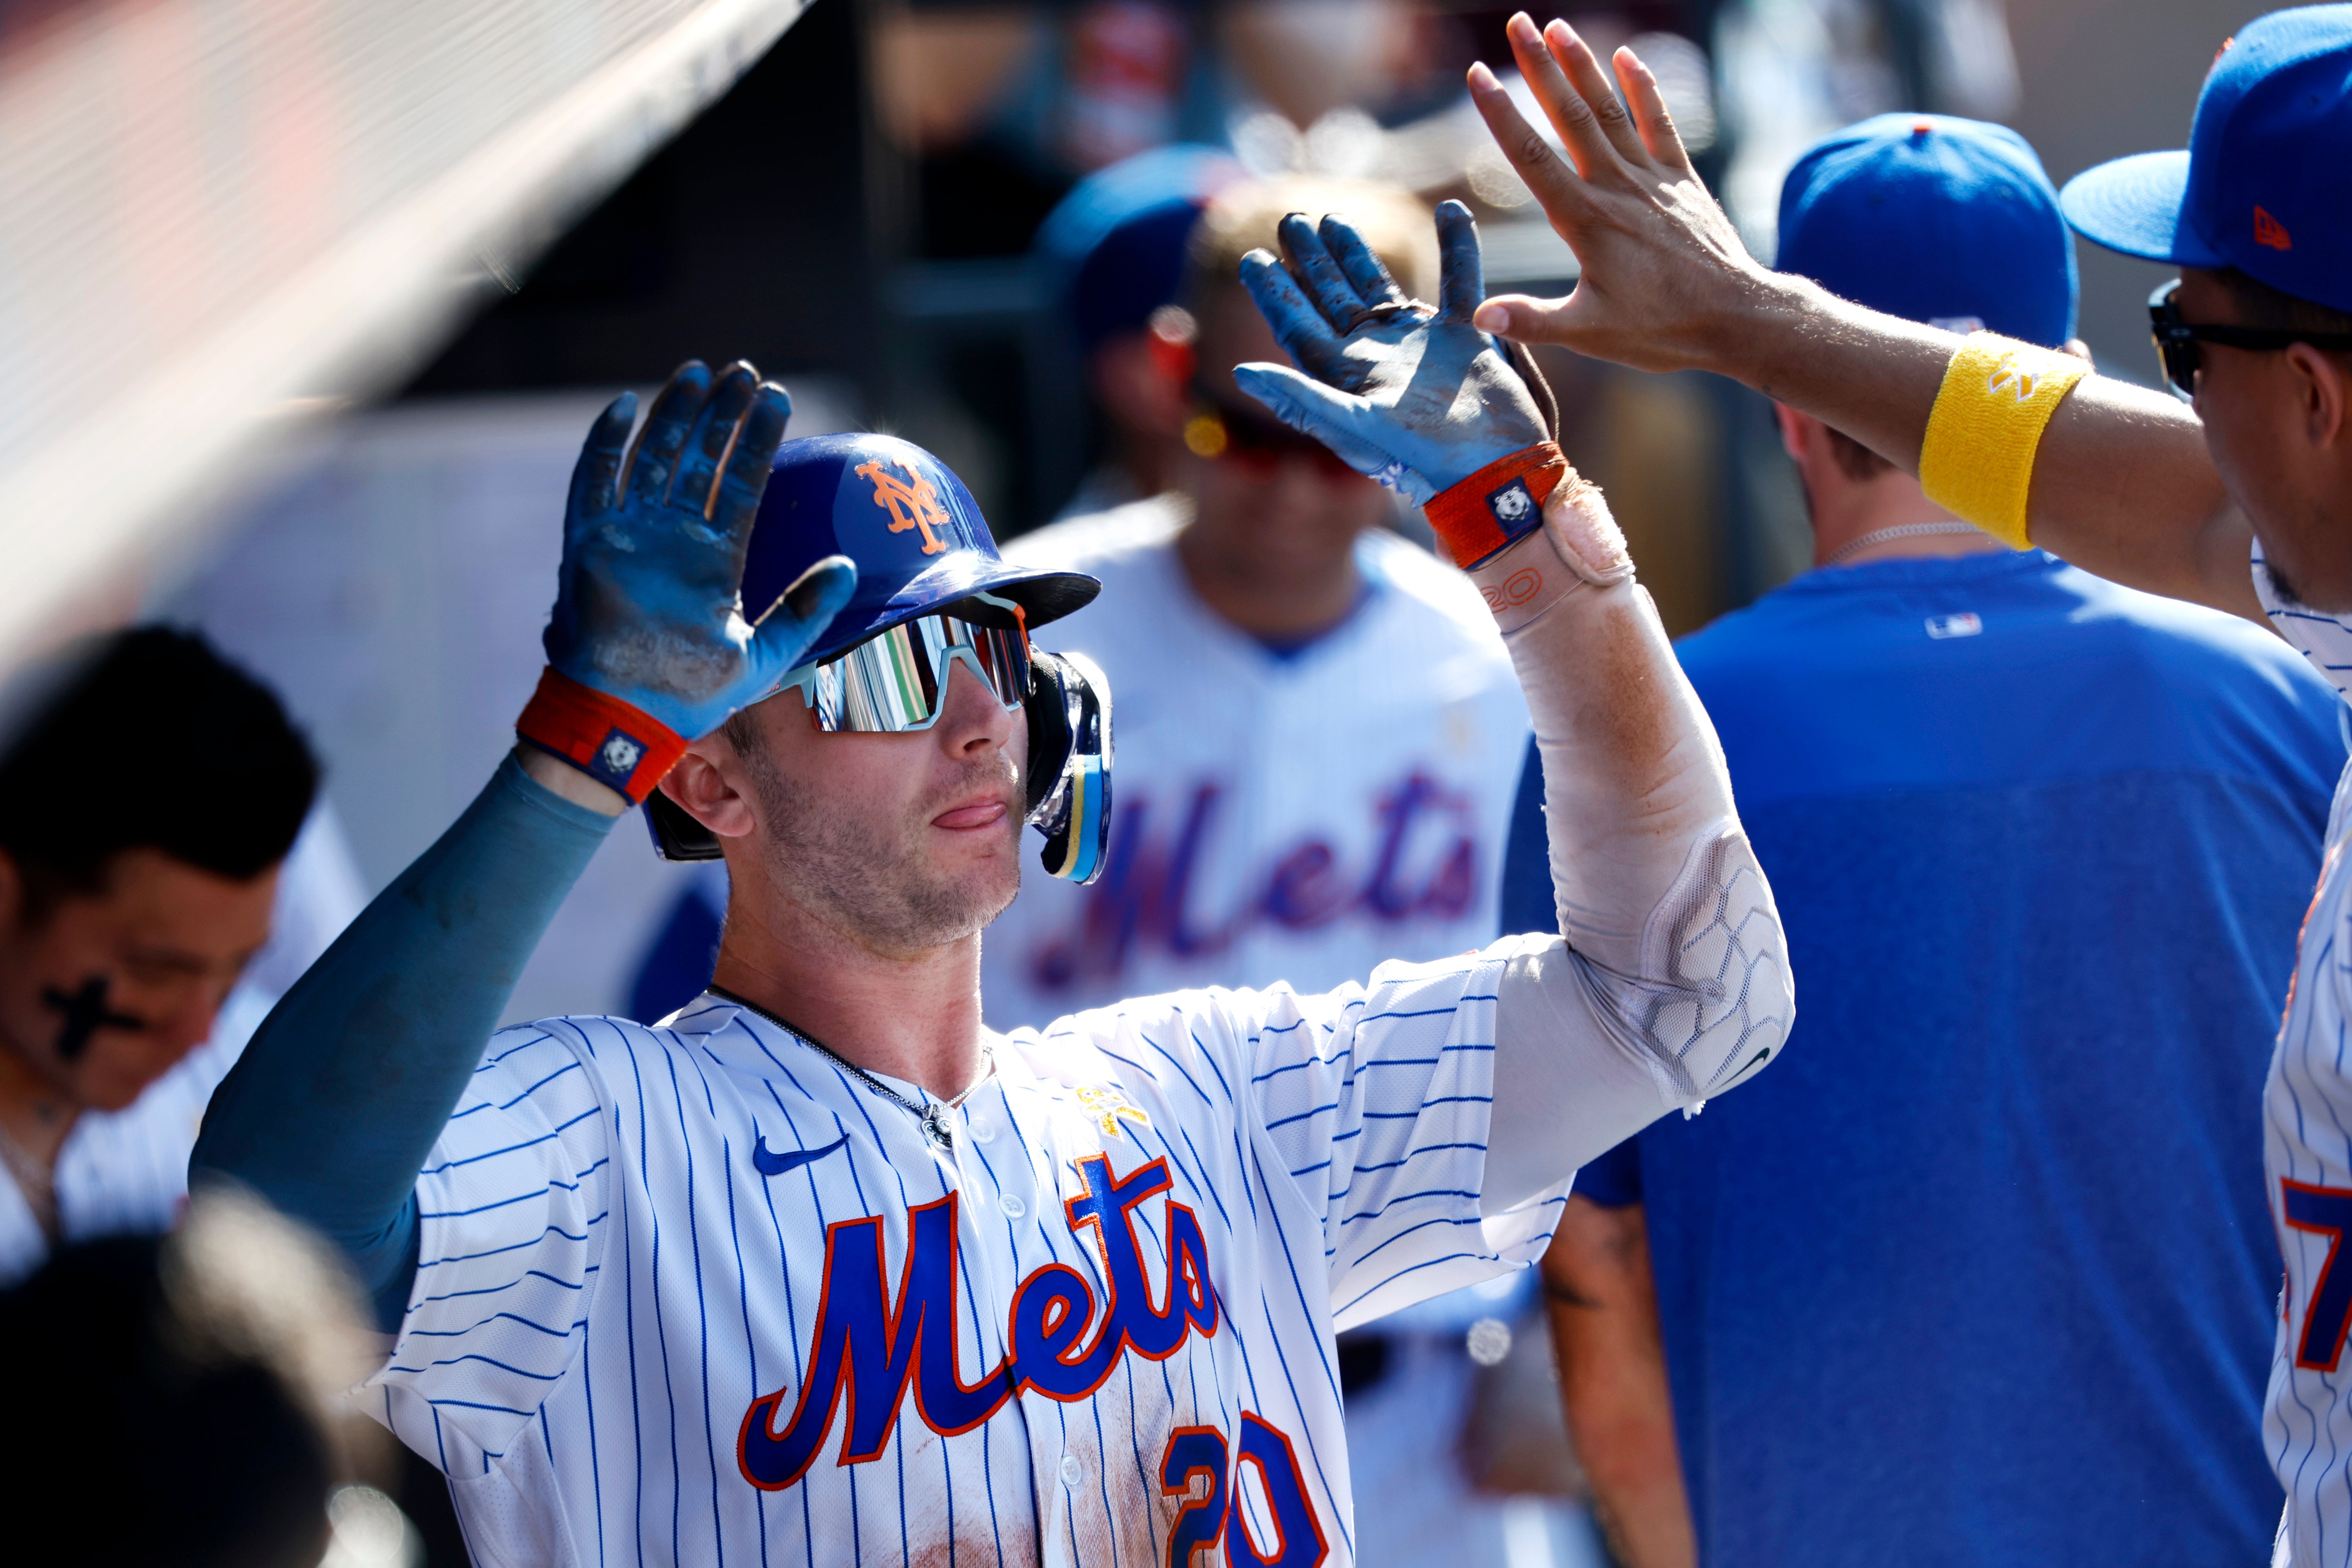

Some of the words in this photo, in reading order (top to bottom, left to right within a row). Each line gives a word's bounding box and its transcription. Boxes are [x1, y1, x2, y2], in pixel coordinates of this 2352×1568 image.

[1481, 568, 1543, 614] 20
[1035, 772, 1480, 990] Mets
[737, 1150, 1219, 1491] Mets
[1159, 1410, 1330, 1568] 20
